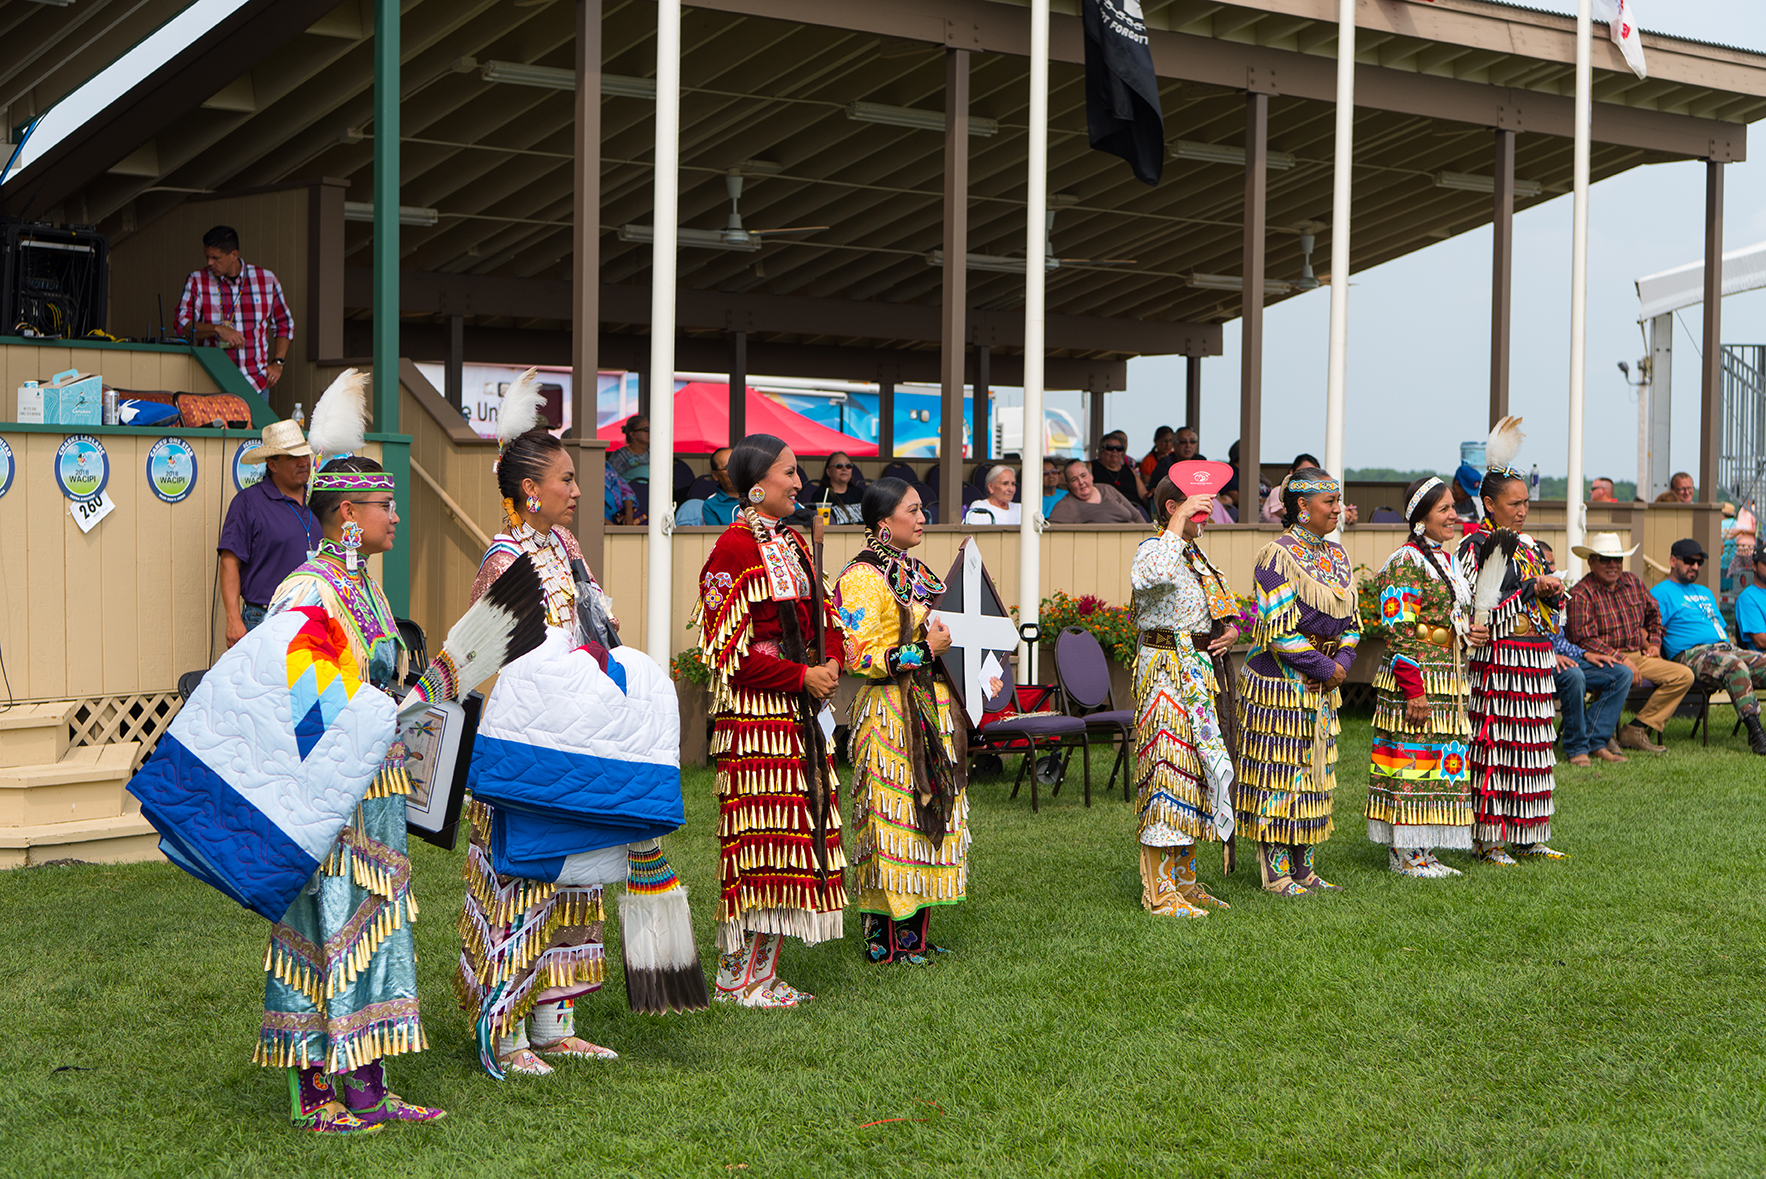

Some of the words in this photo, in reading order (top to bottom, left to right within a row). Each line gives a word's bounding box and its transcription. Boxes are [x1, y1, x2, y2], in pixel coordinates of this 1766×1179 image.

[58, 435, 79, 456] CHASKE
[150, 439, 168, 457] CANKU
[168, 437, 182, 445] ONE
[181, 441, 194, 457] STAR
[69, 475, 97, 483] WACIPI
[160, 476, 186, 484] WACIPI
[79, 496, 103, 520] 260
